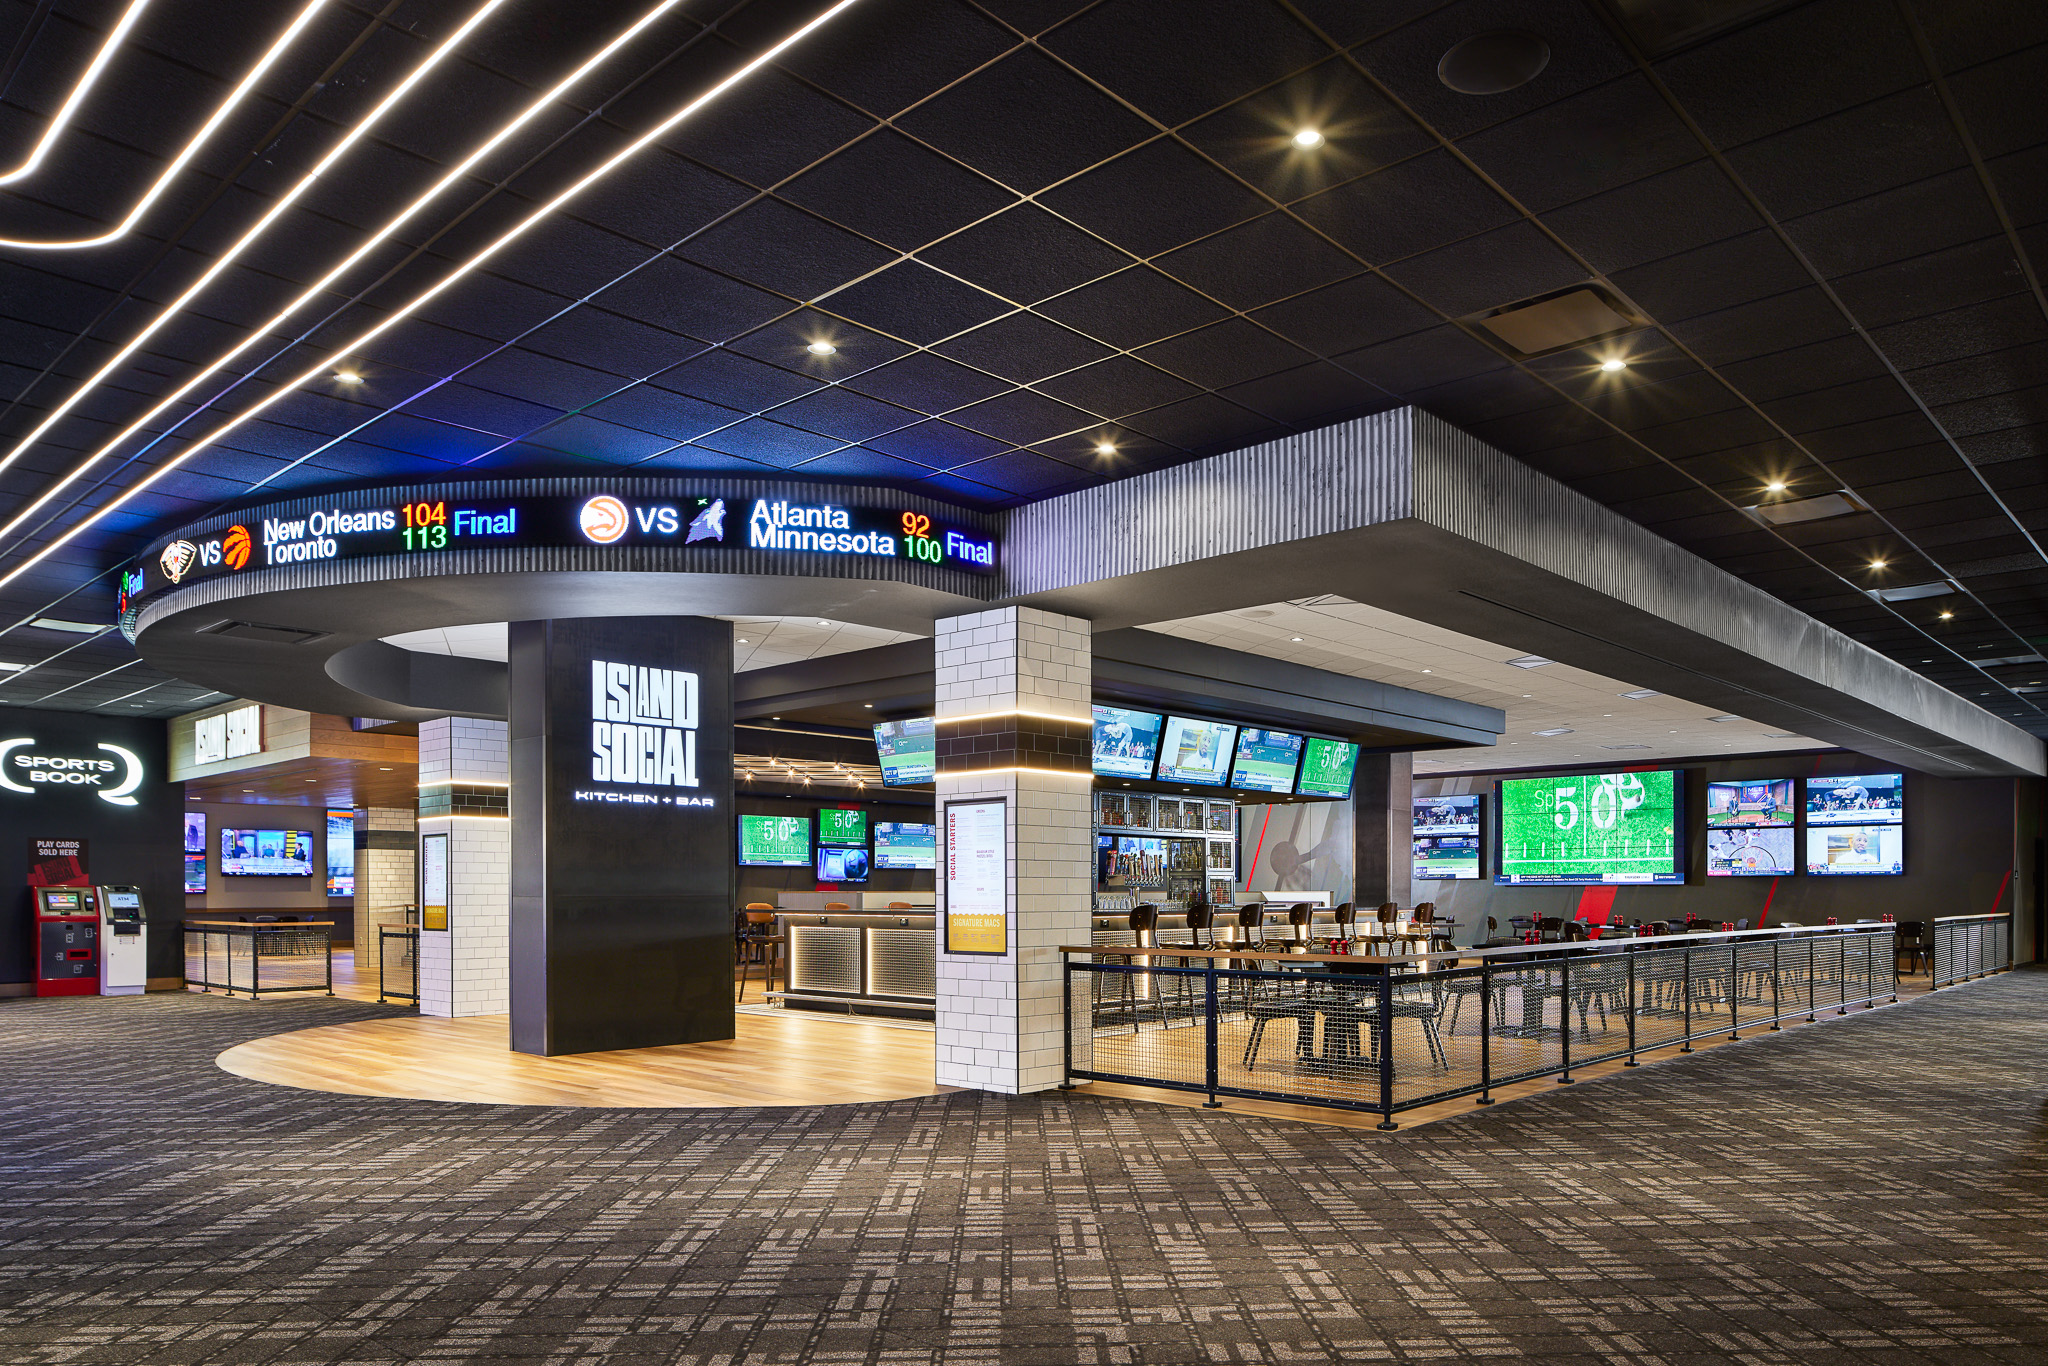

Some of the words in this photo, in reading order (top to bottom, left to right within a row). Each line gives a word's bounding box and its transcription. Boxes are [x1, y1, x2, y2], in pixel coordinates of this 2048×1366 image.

[263, 518, 305, 545] New
[309, 509, 396, 537] Orleans
[402, 502, 446, 527] 104
[454, 508, 515, 536] Final
[635, 507, 679, 533] VS
[750, 500, 850, 530] Atlanta
[902, 511, 930, 539] 92
[265, 536, 337, 565] Toronto
[402, 525, 446, 550] 113
[750, 522, 896, 556] Minnesota
[903, 535, 942, 564] 100
[947, 532, 993, 565] Final
[199, 540, 221, 567] VS
[128, 568, 144, 598] Final
[592, 659, 699, 730] ISLAND
[14, 755, 116, 772] SPORTS
[592, 721, 700, 788] SOCIAL
[29, 770, 102, 785] BOOK
[574, 790, 658, 805] KITCHEN
[675, 796, 715, 807] BAR
[36, 840, 54, 848] PLAY
[55, 840, 80, 849] CARDS
[38, 848, 57, 856] SOLD
[59, 848, 78, 857] HERE
[952, 917, 983, 928] SIGNATURE
[983, 918, 1001, 928] MACS
